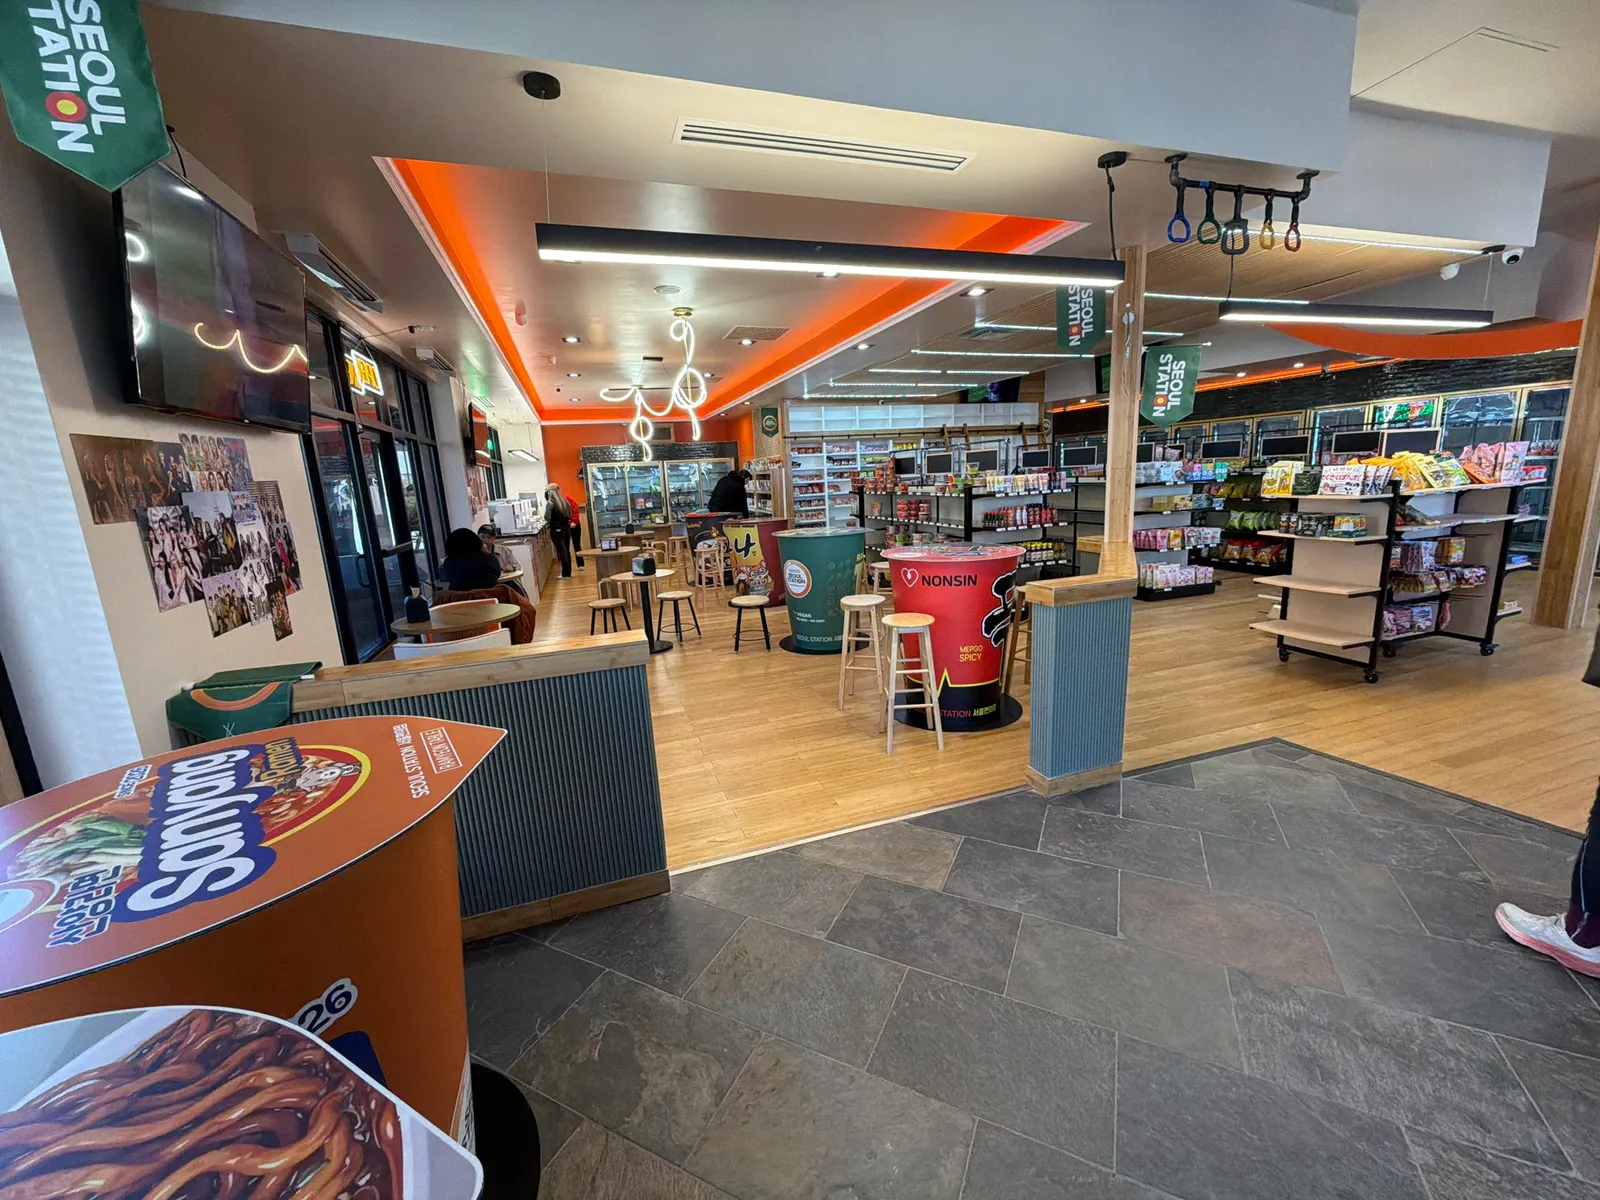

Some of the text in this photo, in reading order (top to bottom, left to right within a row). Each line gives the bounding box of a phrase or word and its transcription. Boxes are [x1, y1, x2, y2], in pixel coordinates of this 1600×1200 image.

[28, 0, 95, 153] TATION
[65, 0, 126, 135] SEOUL
[1068, 284, 1081, 347] STATION
[1081, 288, 1094, 338] SEOUL
[1152, 353, 1173, 417] STATION
[1167, 360, 1187, 411] SEOUL
[921, 574, 978, 587] NONSIN
[959, 653, 983, 662] SPICY
[425, 729, 446, 746] TABLE
[940, 709, 972, 718] TATION
[259, 738, 301, 782] Ramen
[400, 745, 422, 773] STATION
[407, 770, 430, 799] SEOUL
[126, 749, 259, 912] Sanyang
[46, 863, 123, 948] 산양라면
